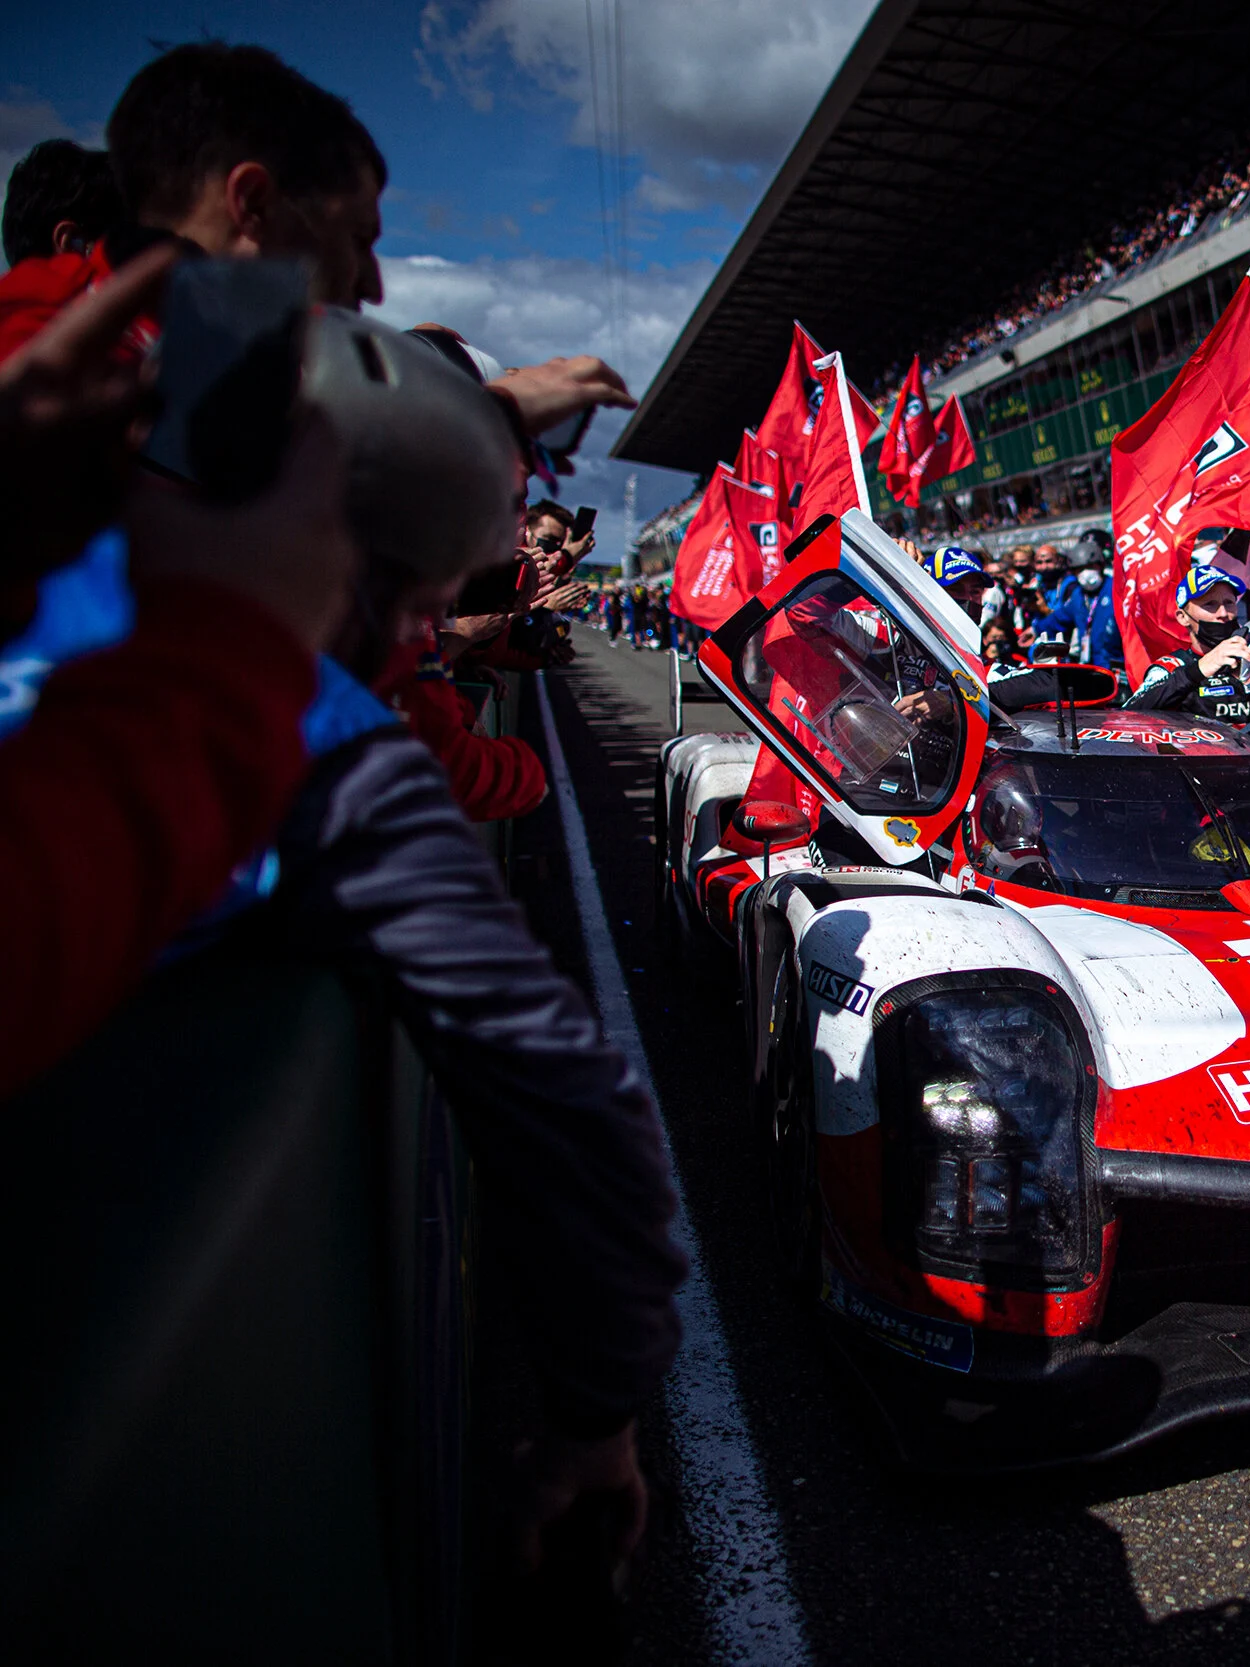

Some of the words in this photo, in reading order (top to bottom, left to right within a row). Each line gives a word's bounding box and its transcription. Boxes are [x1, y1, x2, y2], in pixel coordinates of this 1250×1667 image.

[1076, 727, 1224, 744] DENSO
[810, 966, 869, 1013] AISIN
[848, 1296, 954, 1353] MICHELIN
